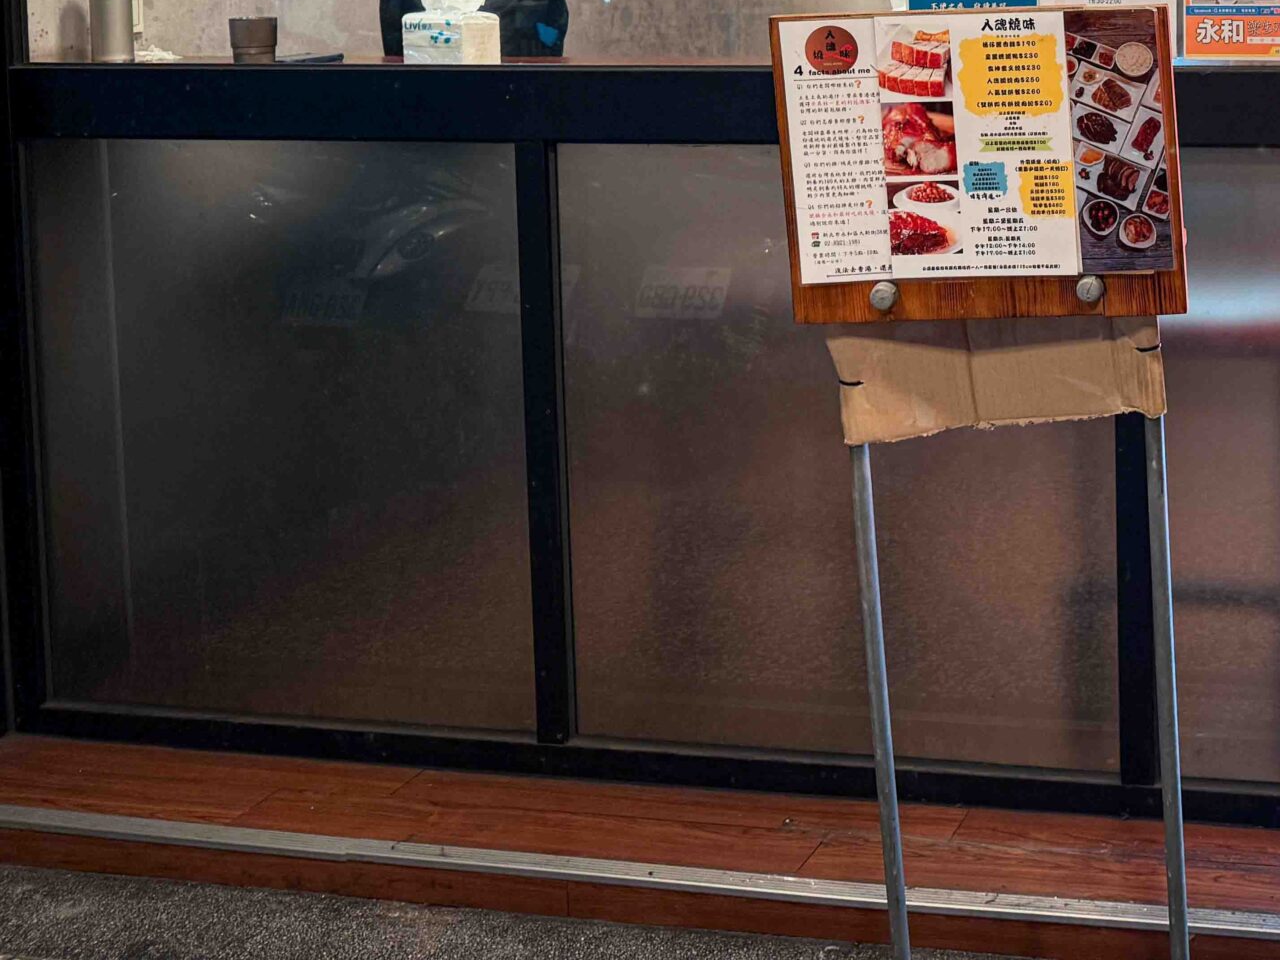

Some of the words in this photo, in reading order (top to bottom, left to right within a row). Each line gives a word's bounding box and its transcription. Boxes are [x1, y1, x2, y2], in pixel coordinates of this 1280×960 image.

[981, 17, 1036, 31] 入魂燒味
[1196, 18, 1245, 44] 永和
[794, 65, 804, 76] 4
